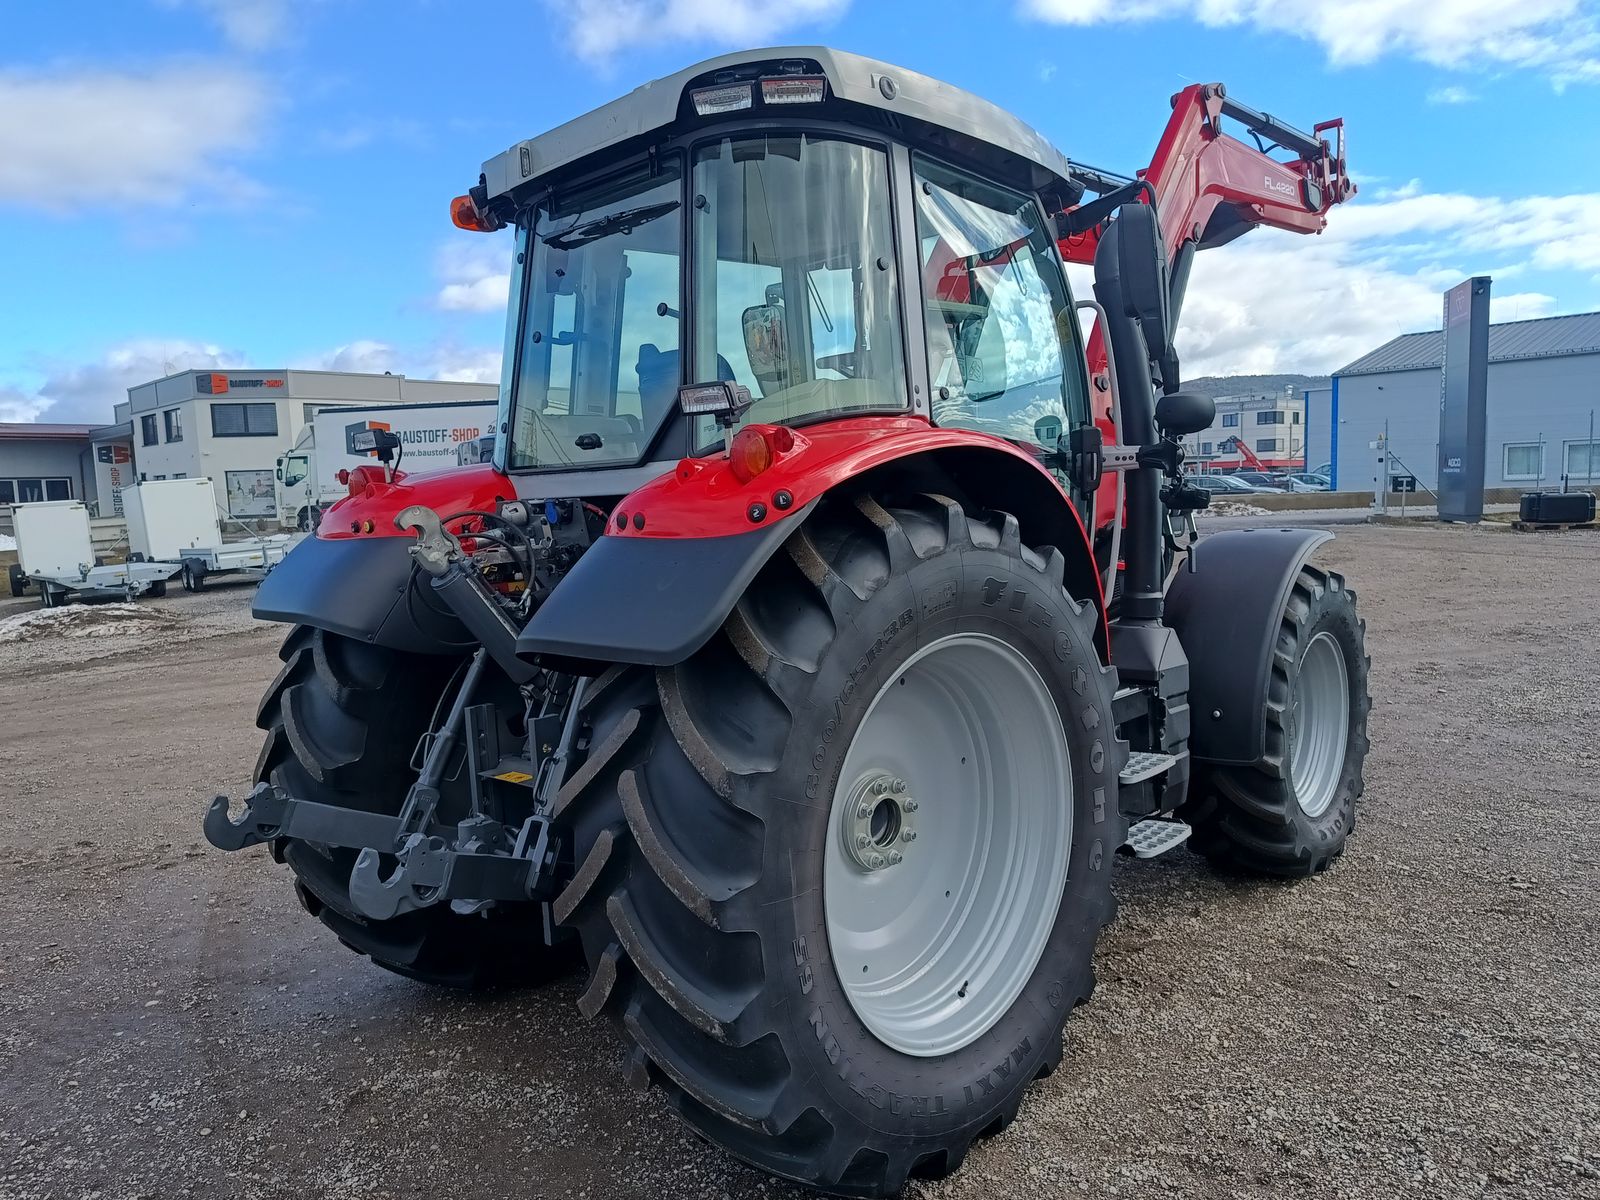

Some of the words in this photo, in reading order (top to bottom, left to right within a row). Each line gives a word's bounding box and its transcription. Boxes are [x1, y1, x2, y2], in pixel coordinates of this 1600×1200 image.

[229, 379, 284, 388] BAUSTOFF-SHOP
[110, 467, 125, 518] USTOFF-SHOP
[792, 935, 815, 996] 65
[808, 1006, 950, 1118] TRACTION
[963, 1034, 1033, 1107] MAXI
